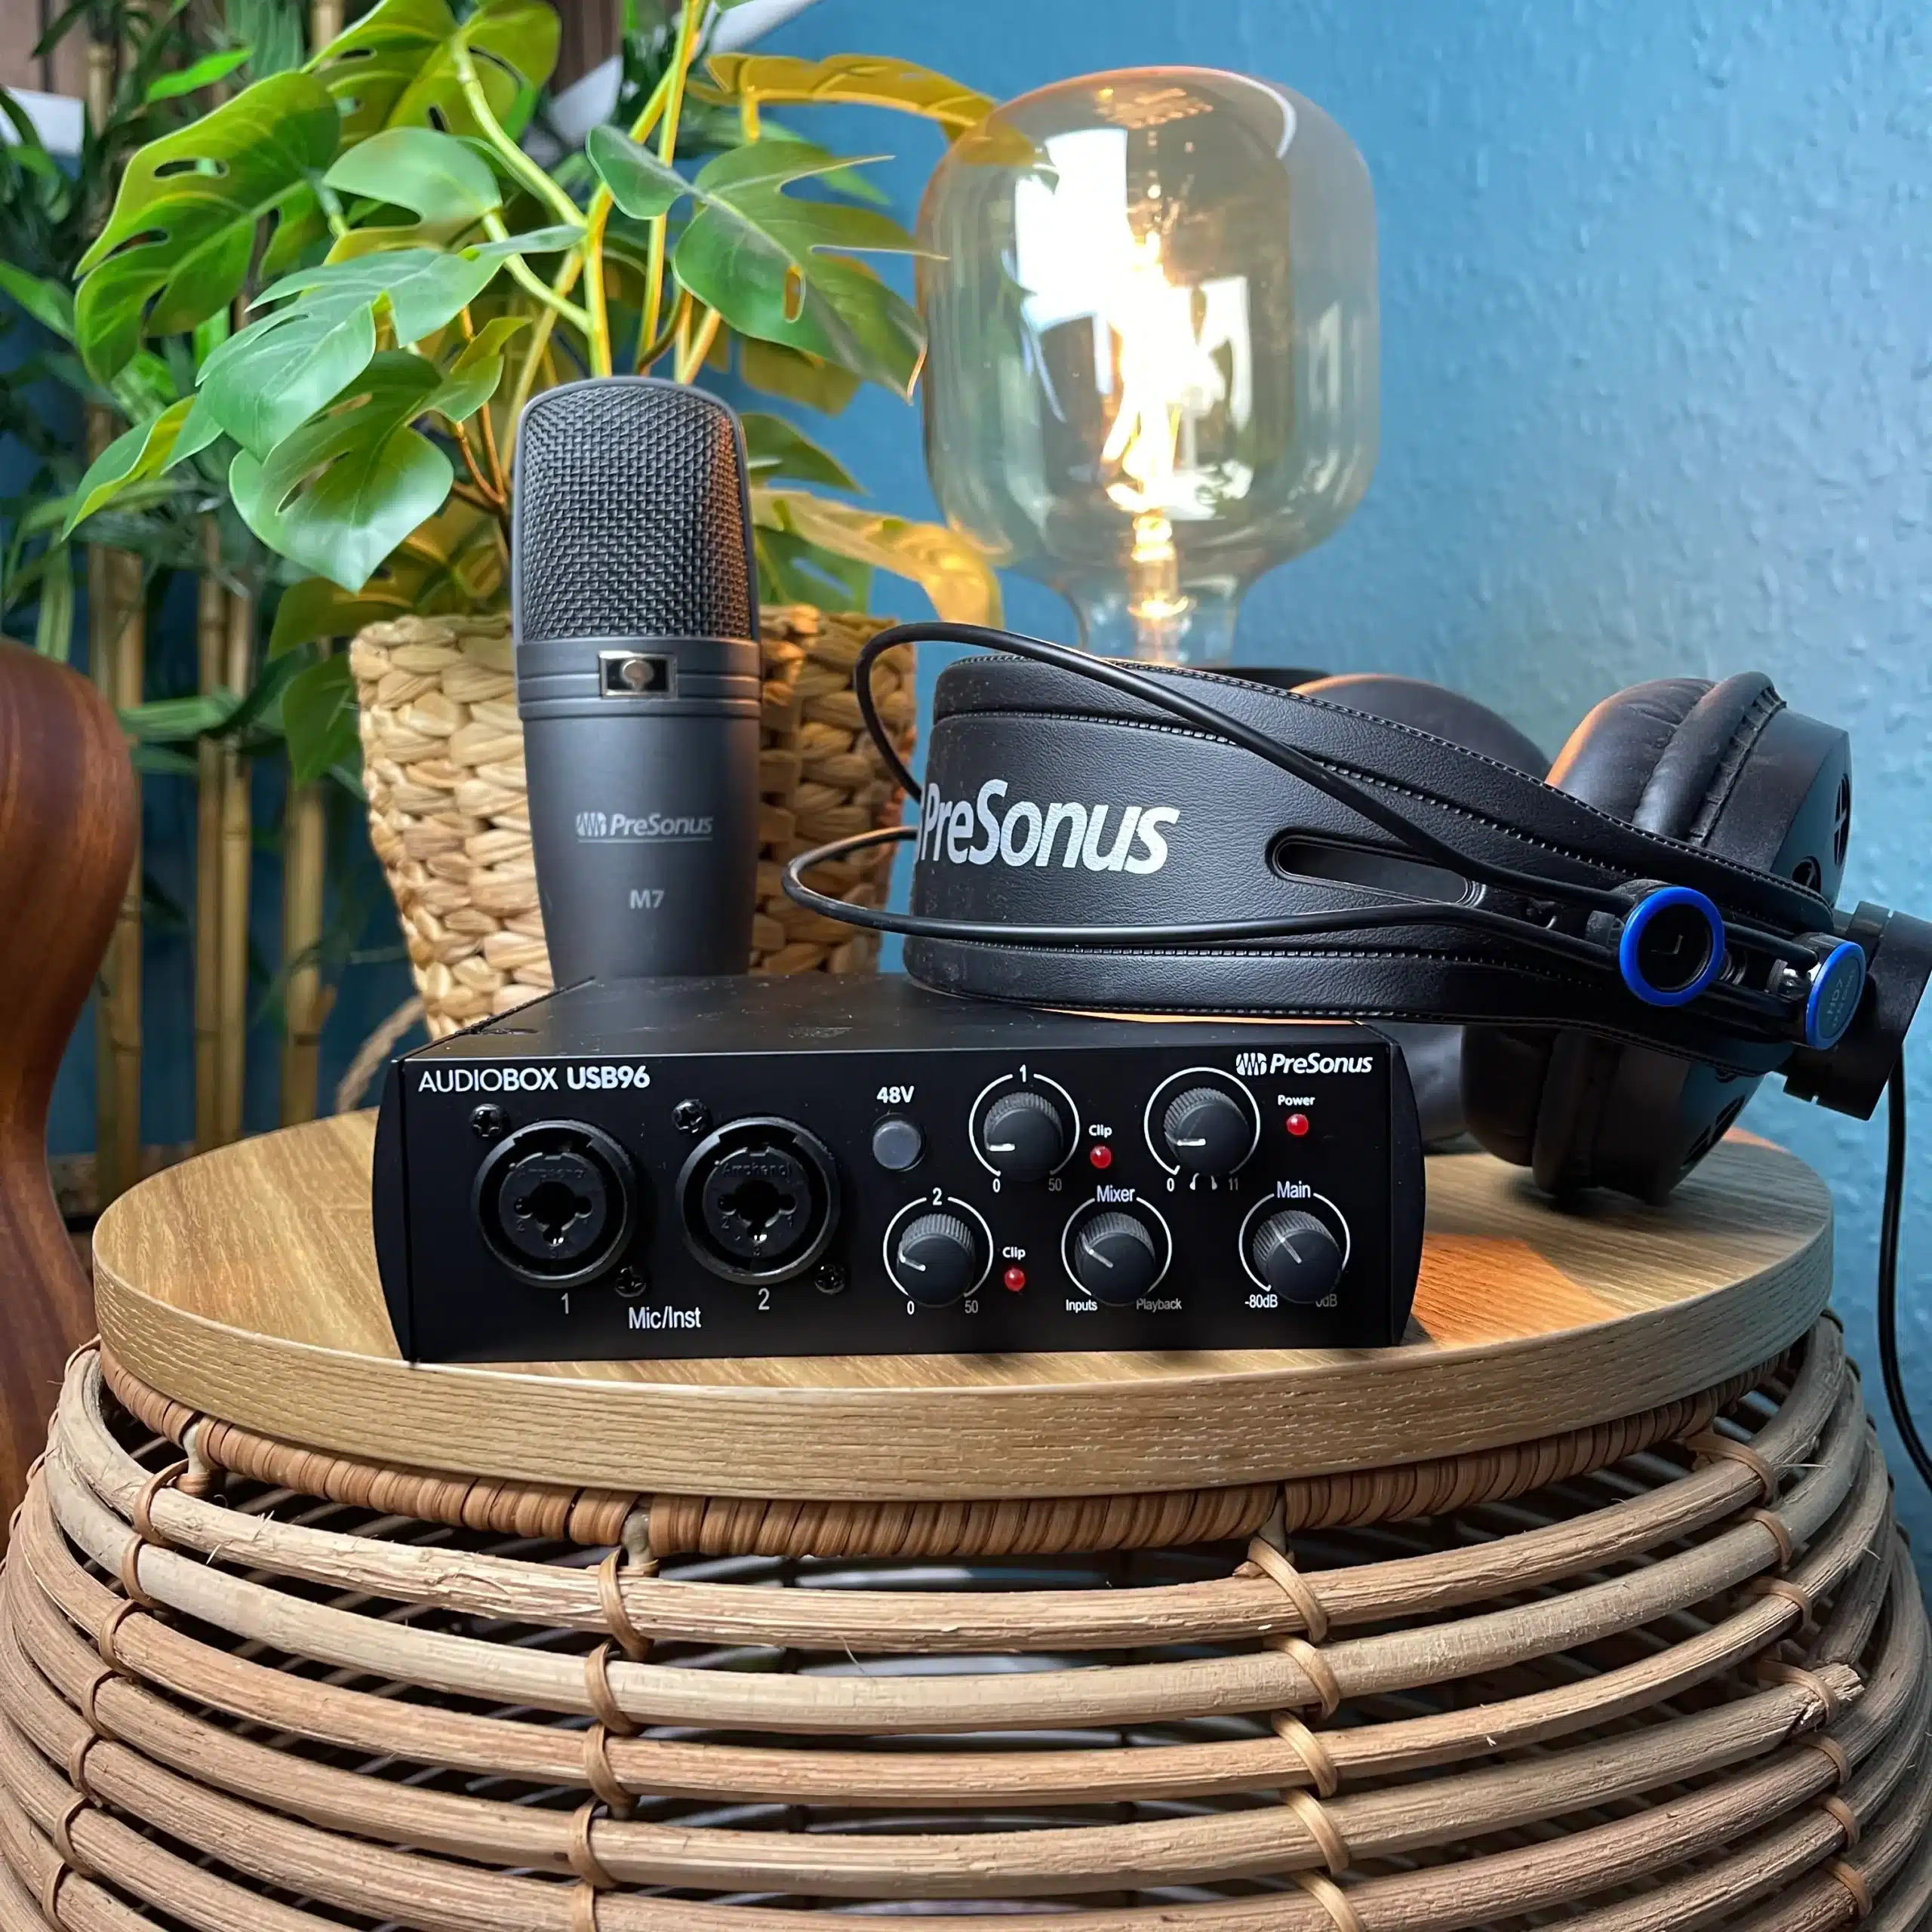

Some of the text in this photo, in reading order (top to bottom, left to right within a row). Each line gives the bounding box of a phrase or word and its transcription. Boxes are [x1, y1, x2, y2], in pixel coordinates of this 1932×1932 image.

[609, 812, 713, 836] PreSonus
[921, 778, 1180, 875] PreSonus
[629, 888, 664, 909] M7
[1269, 1052, 1374, 1075] PreSonus
[418, 1065, 651, 1093] AUDIOBOX USB96
[1019, 1064, 1027, 1082] 1
[876, 1085, 915, 1104] 48V
[1277, 1094, 1315, 1106] Power
[1088, 1124, 1112, 1139] Clip
[992, 1178, 1001, 1193] 0
[1048, 1178, 1063, 1192] 50
[1166, 1177, 1175, 1192] 0
[1228, 1177, 1239, 1191] 11
[1277, 1180, 1312, 1198] Main
[932, 1187, 943, 1206] 2
[1097, 1184, 1136, 1203] Mixer
[1002, 1246, 1026, 1260] Clip
[561, 1292, 570, 1315] 1
[758, 1287, 771, 1310] 2
[906, 1300, 915, 1315] 0
[964, 1300, 979, 1314] 50
[1066, 1299, 1098, 1315] Inputs
[1136, 1297, 1183, 1313] Playback
[1244, 1294, 1279, 1309] -80dB
[629, 1306, 702, 1329] Mic/Inst
